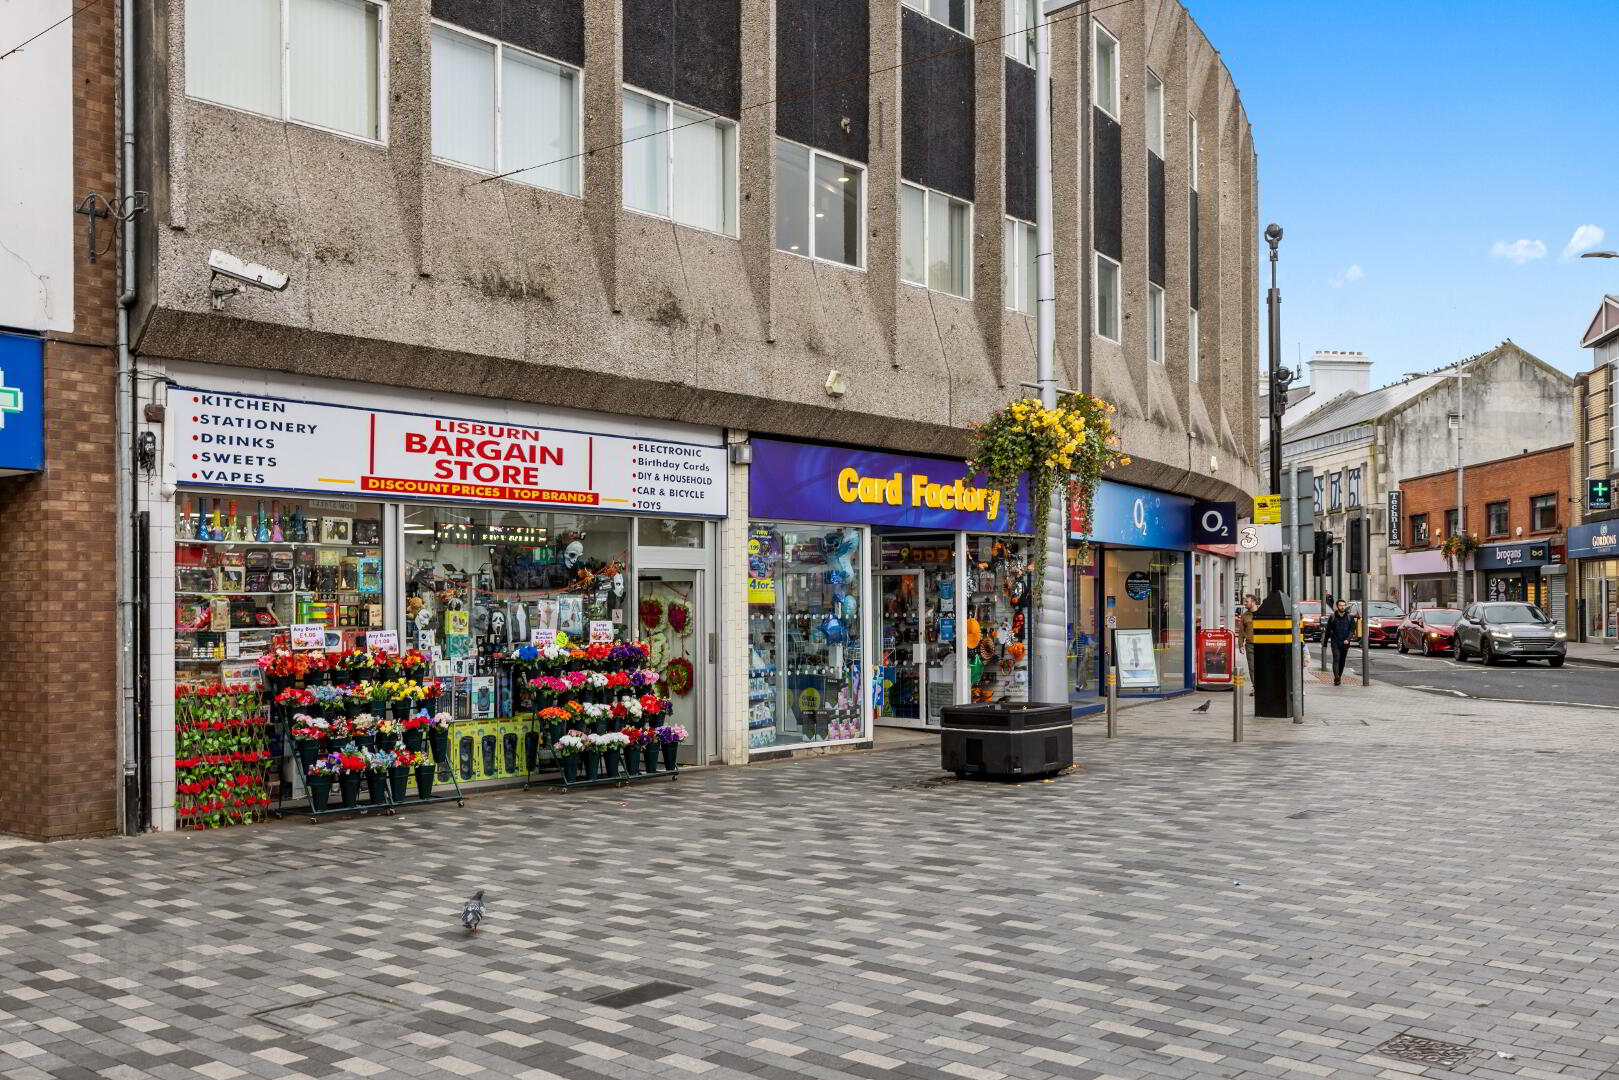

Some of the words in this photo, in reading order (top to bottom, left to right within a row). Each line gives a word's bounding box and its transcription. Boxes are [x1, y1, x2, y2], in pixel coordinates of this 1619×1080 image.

[201, 394, 286, 413] KITCHEN
[200, 414, 318, 435] STATIONERY
[435, 419, 540, 442] LISBURN
[201, 433, 275, 449] DRINKS
[405, 432, 564, 466] BARGAIN
[638, 443, 702, 458] ELECTRONIC
[201, 452, 277, 467] SWEETS
[638, 458, 681, 471] Birthday
[683, 462, 710, 472] Cards
[200, 470, 265, 484] VAPES
[434, 459, 539, 486] STORE
[638, 472, 652, 481] DIY
[663, 474, 713, 485] HOUSEHOLD
[368, 478, 450, 494] DISCOUNT
[451, 484, 500, 498] PRICES
[513, 488, 542, 499] TOP
[542, 491, 594, 503] BRANDS
[637, 486, 656, 496] CAR
[659, 488, 666, 496] &
[669, 488, 705, 499] BICYCLE
[838, 467, 903, 505] Card
[911, 474, 1001, 520] Factory
[637, 501, 661, 510] TOYS
[1132, 498, 1148, 536] O2
[1201, 510, 1229, 537] O2
[1390, 492, 1399, 540] Technics
[1240, 527, 1259, 549] 3
[1592, 535, 1617, 547] GORDONS
[1496, 547, 1521, 565] brogans
